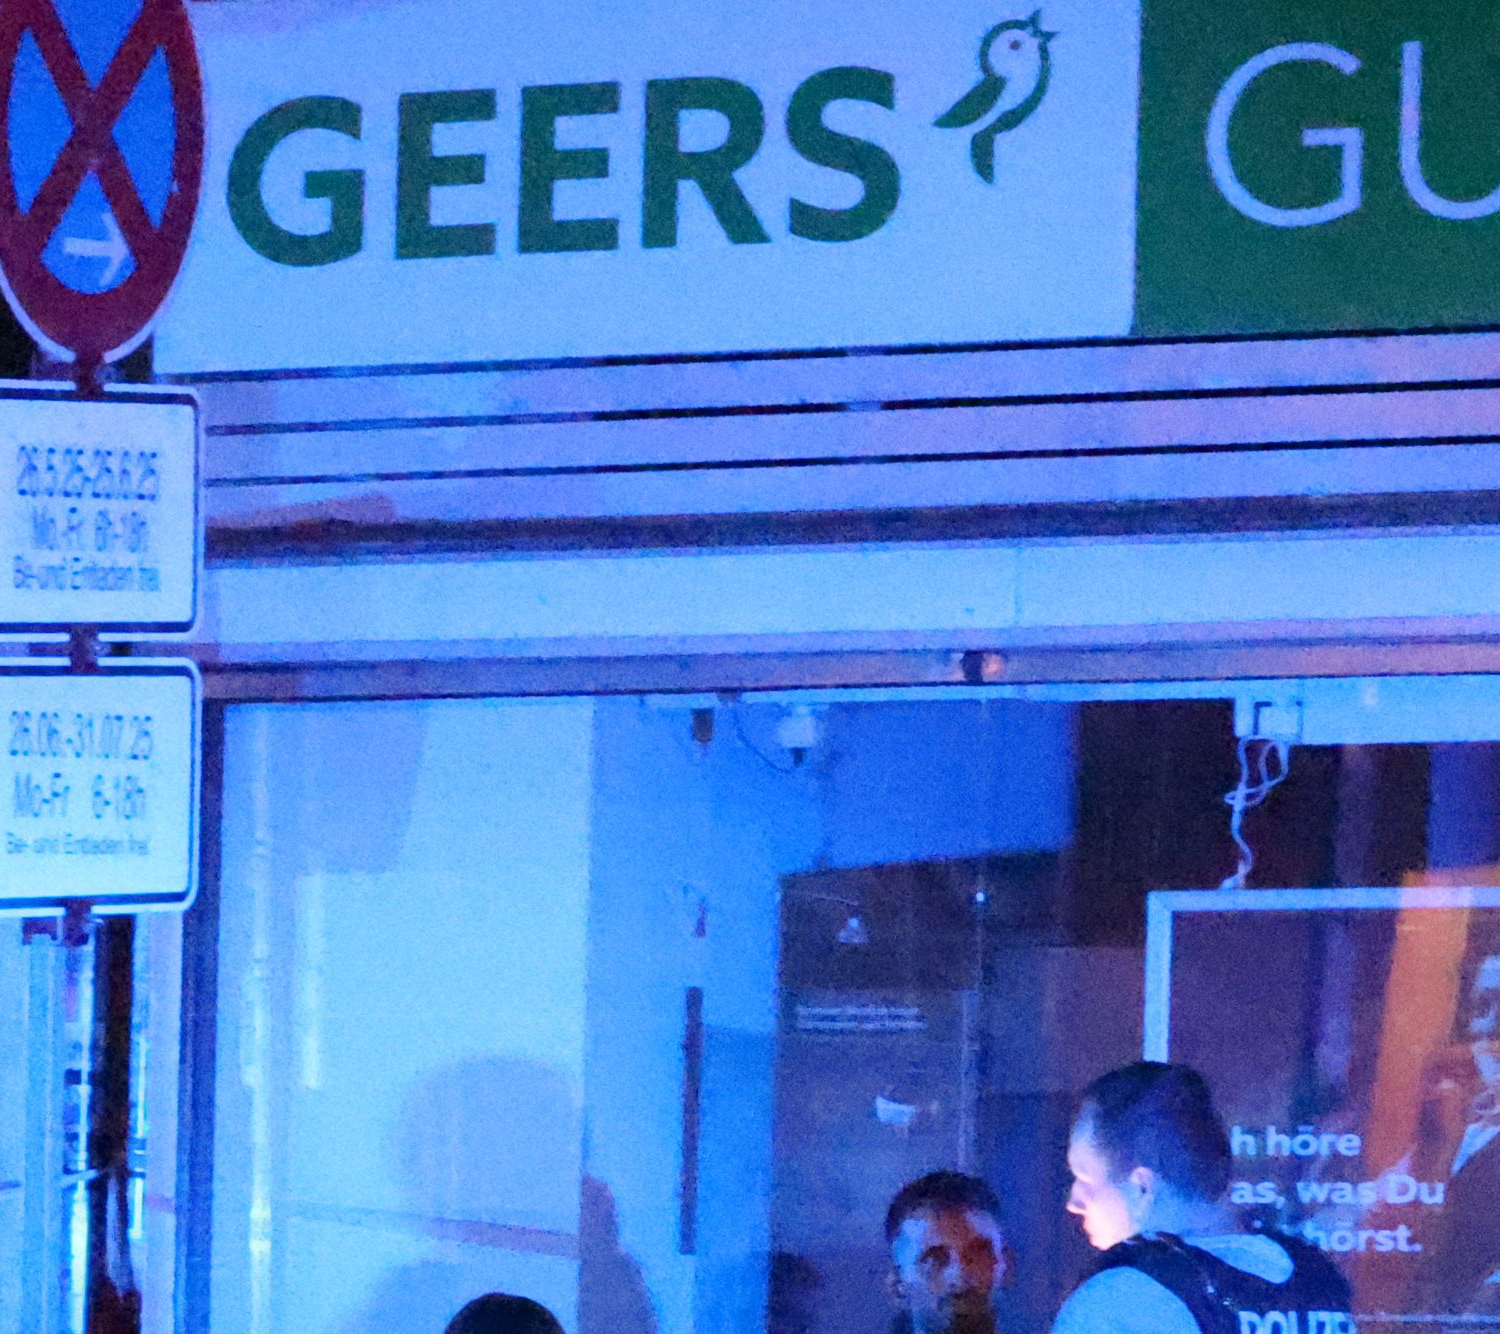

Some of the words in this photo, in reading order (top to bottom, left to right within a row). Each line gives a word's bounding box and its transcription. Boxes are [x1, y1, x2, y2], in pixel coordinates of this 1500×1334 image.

[225, 65, 901, 267] GEERS
[1265, 1124, 1362, 1157] höre
[1230, 1180, 1285, 1210] as,
[1296, 1181, 1378, 1204] was
[1384, 1174, 1446, 1205] Du
